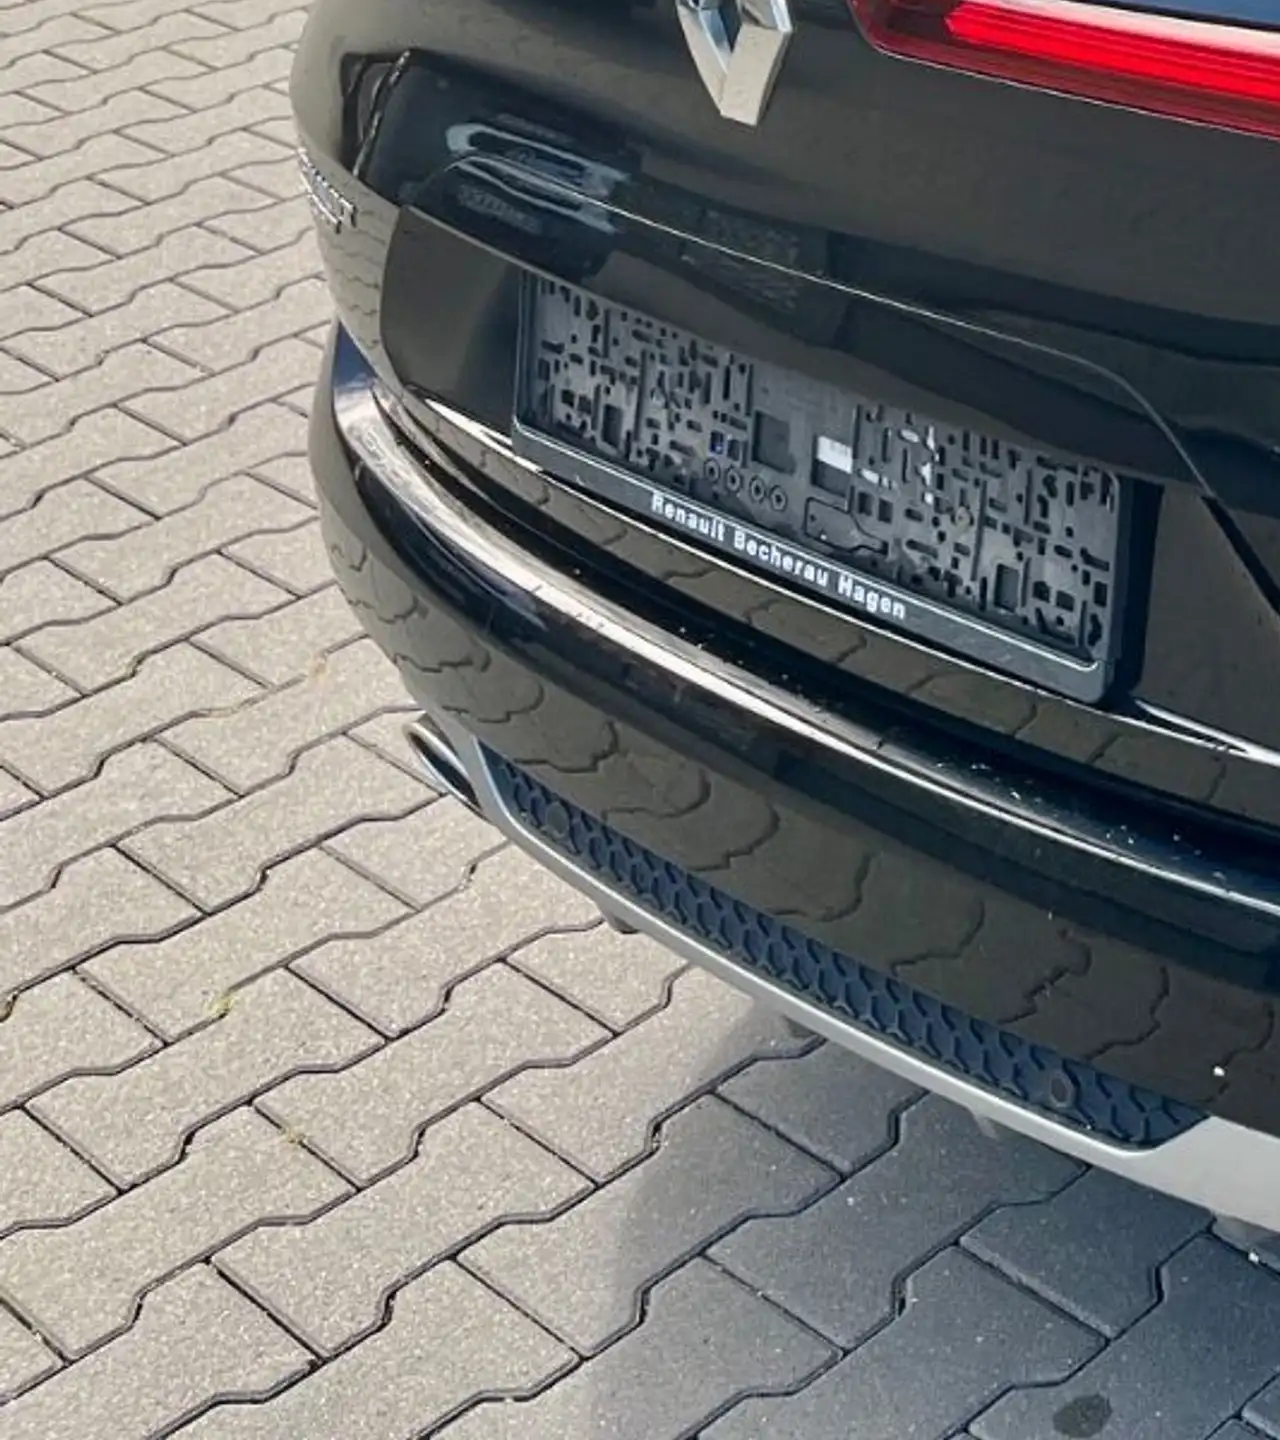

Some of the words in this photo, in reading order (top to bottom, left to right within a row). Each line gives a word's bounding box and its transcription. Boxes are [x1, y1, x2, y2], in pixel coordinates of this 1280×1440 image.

[651, 492, 725, 542] Renault
[733, 530, 829, 588] Becherau
[837, 575, 906, 621] Hagen
